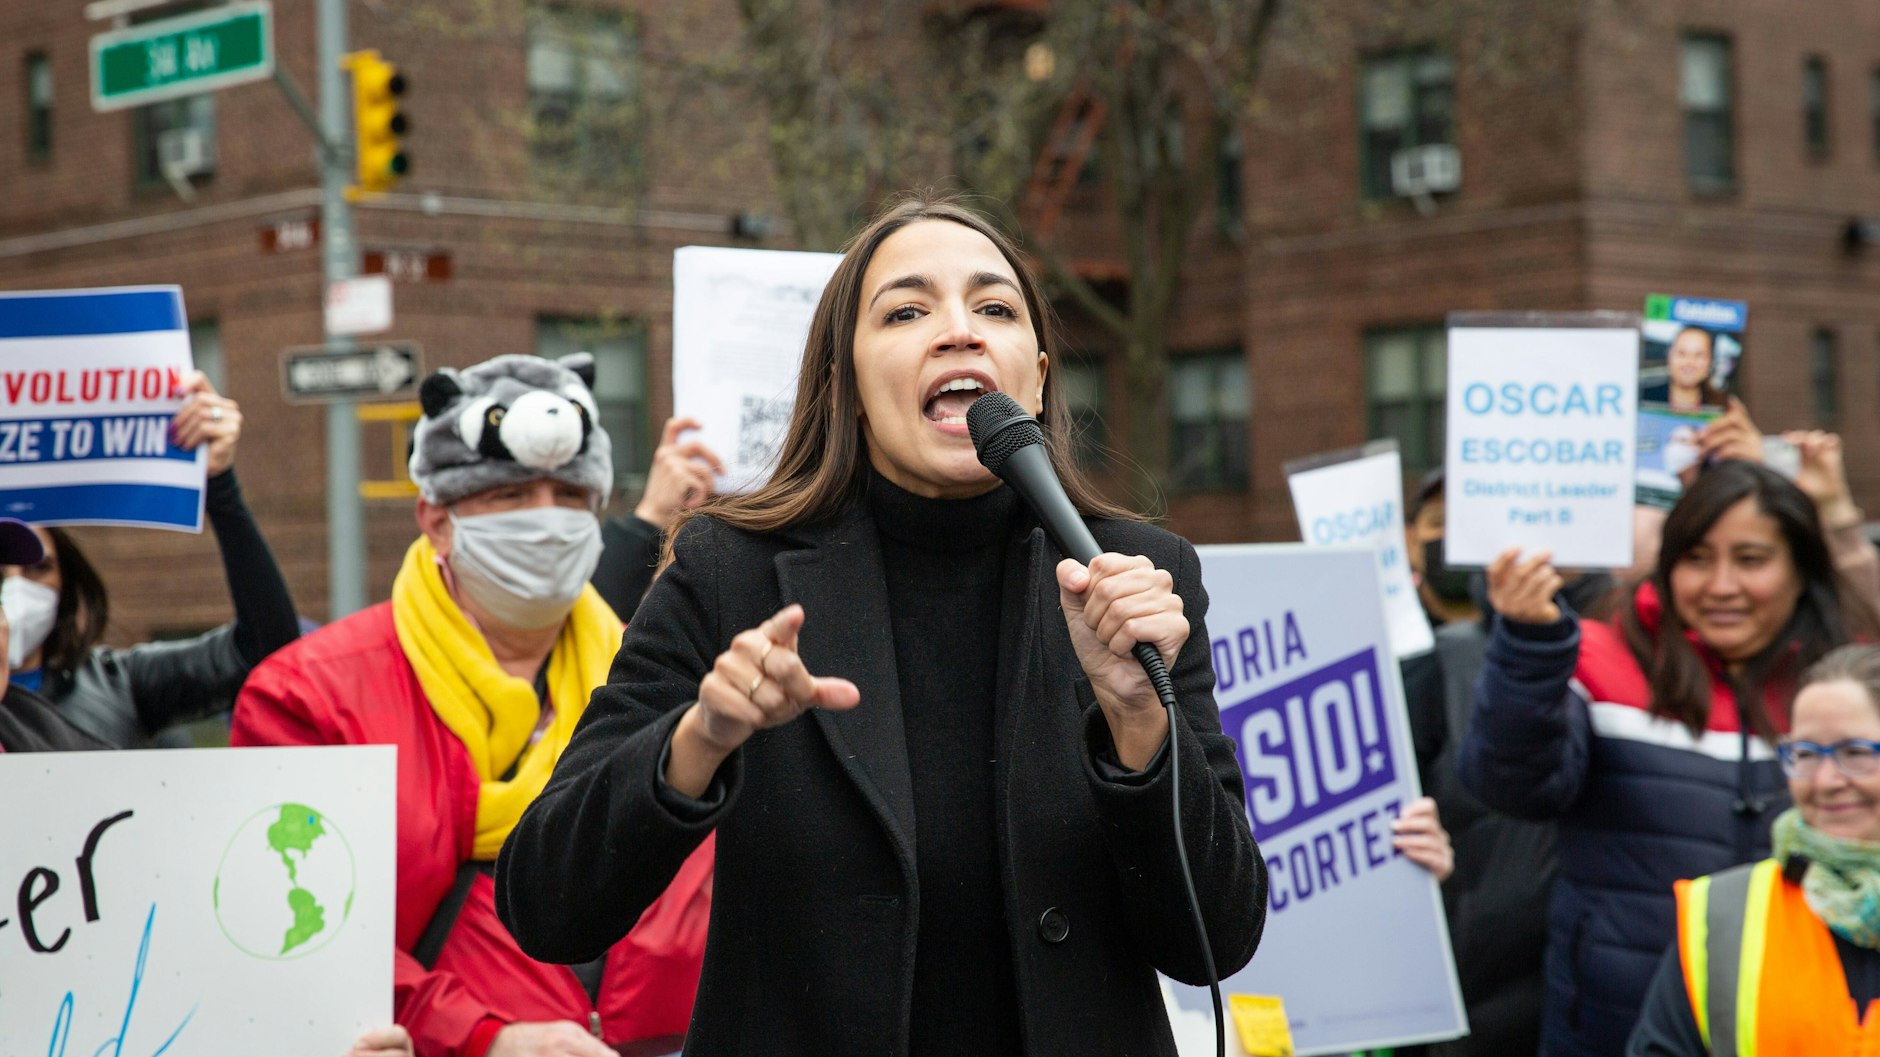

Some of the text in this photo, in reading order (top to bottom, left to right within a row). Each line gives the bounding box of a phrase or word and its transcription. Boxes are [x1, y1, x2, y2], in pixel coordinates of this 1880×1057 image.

[0, 367, 185, 405] VOLUTION
[1463, 382, 1624, 417] OSCAR
[0, 416, 169, 462] ZE TO WIN
[1461, 439, 1624, 465] ESCOBAR
[1463, 480, 1619, 498] District Leader
[1241, 669, 1386, 832] SIO!
[0, 810, 134, 954] er
